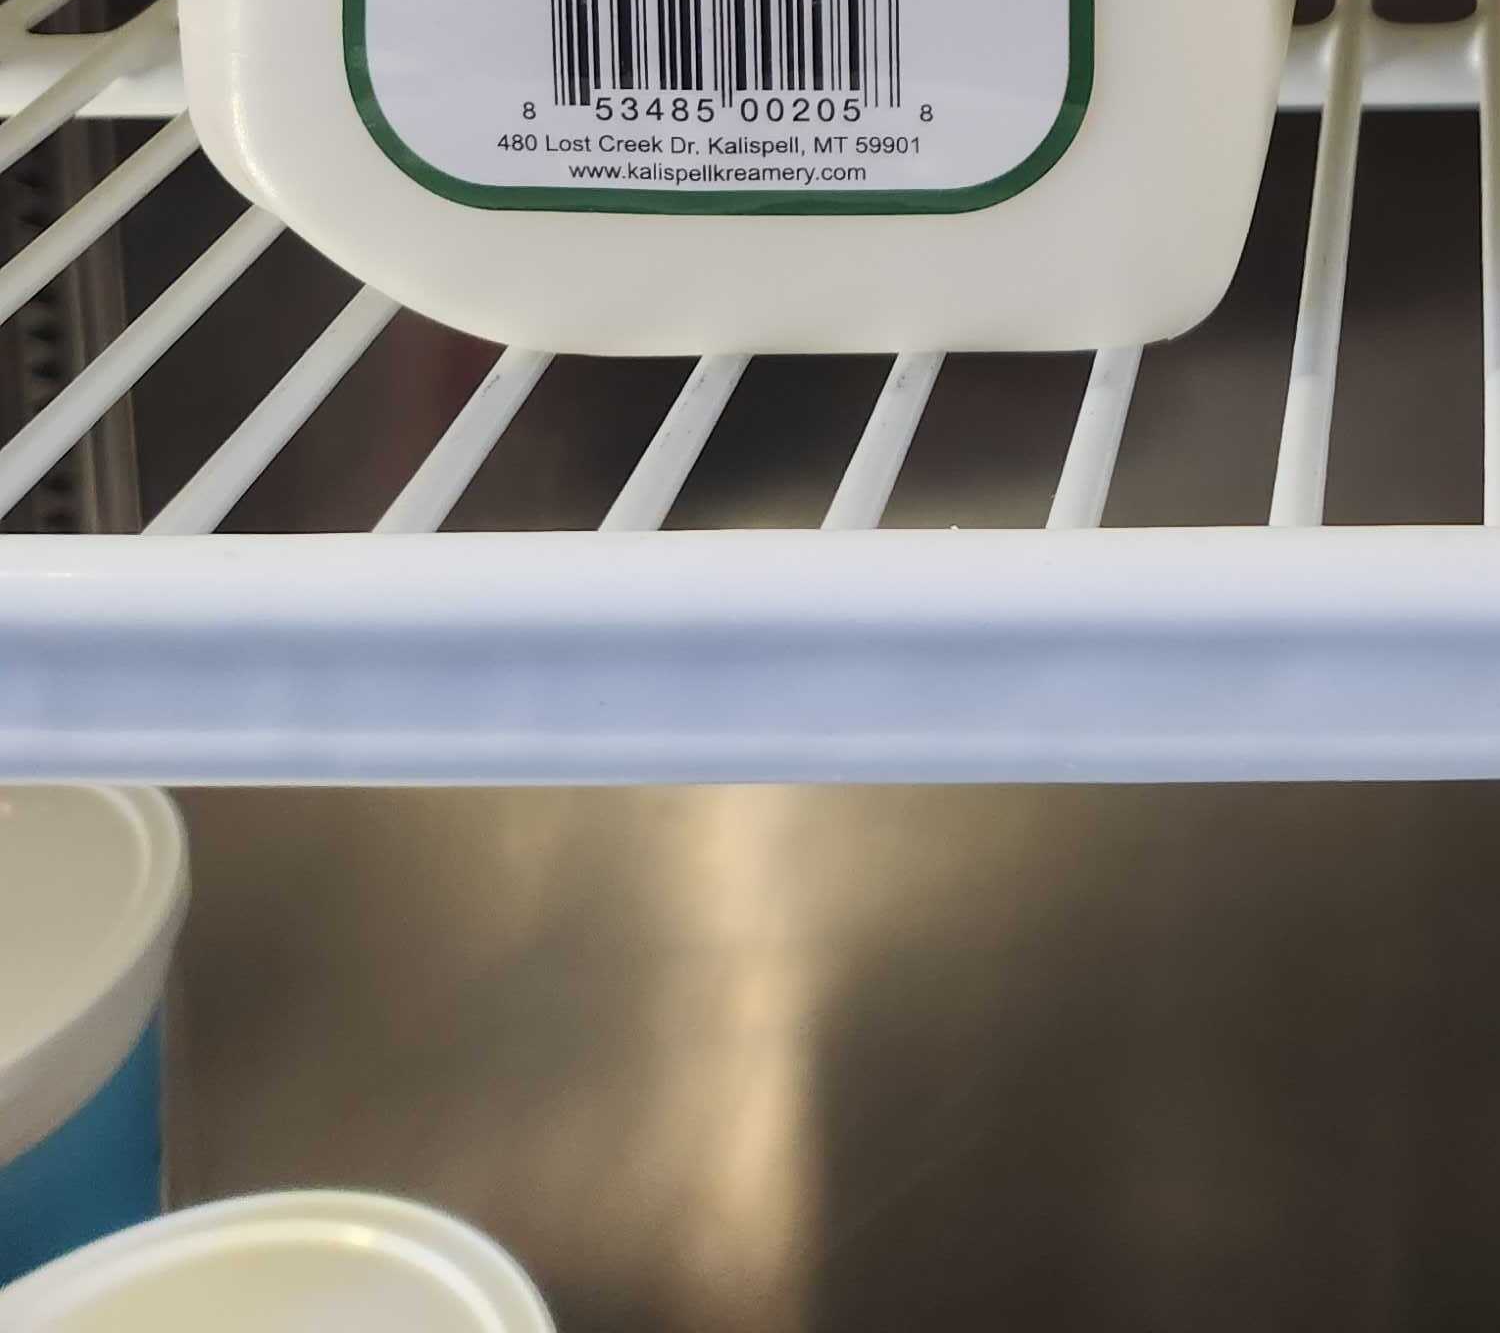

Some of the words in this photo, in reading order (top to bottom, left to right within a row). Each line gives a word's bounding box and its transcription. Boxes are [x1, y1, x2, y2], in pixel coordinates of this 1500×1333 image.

[498, 134, 538, 152] 480
[546, 135, 591, 152] Lost
[599, 135, 663, 153] Creek
[671, 136, 699, 154] Dr.
[709, 137, 805, 158] Kalispell,
[814, 137, 847, 153] MT
[855, 137, 920, 154] 59901
[569, 161, 866, 184] www.kalispellkreamery.com
